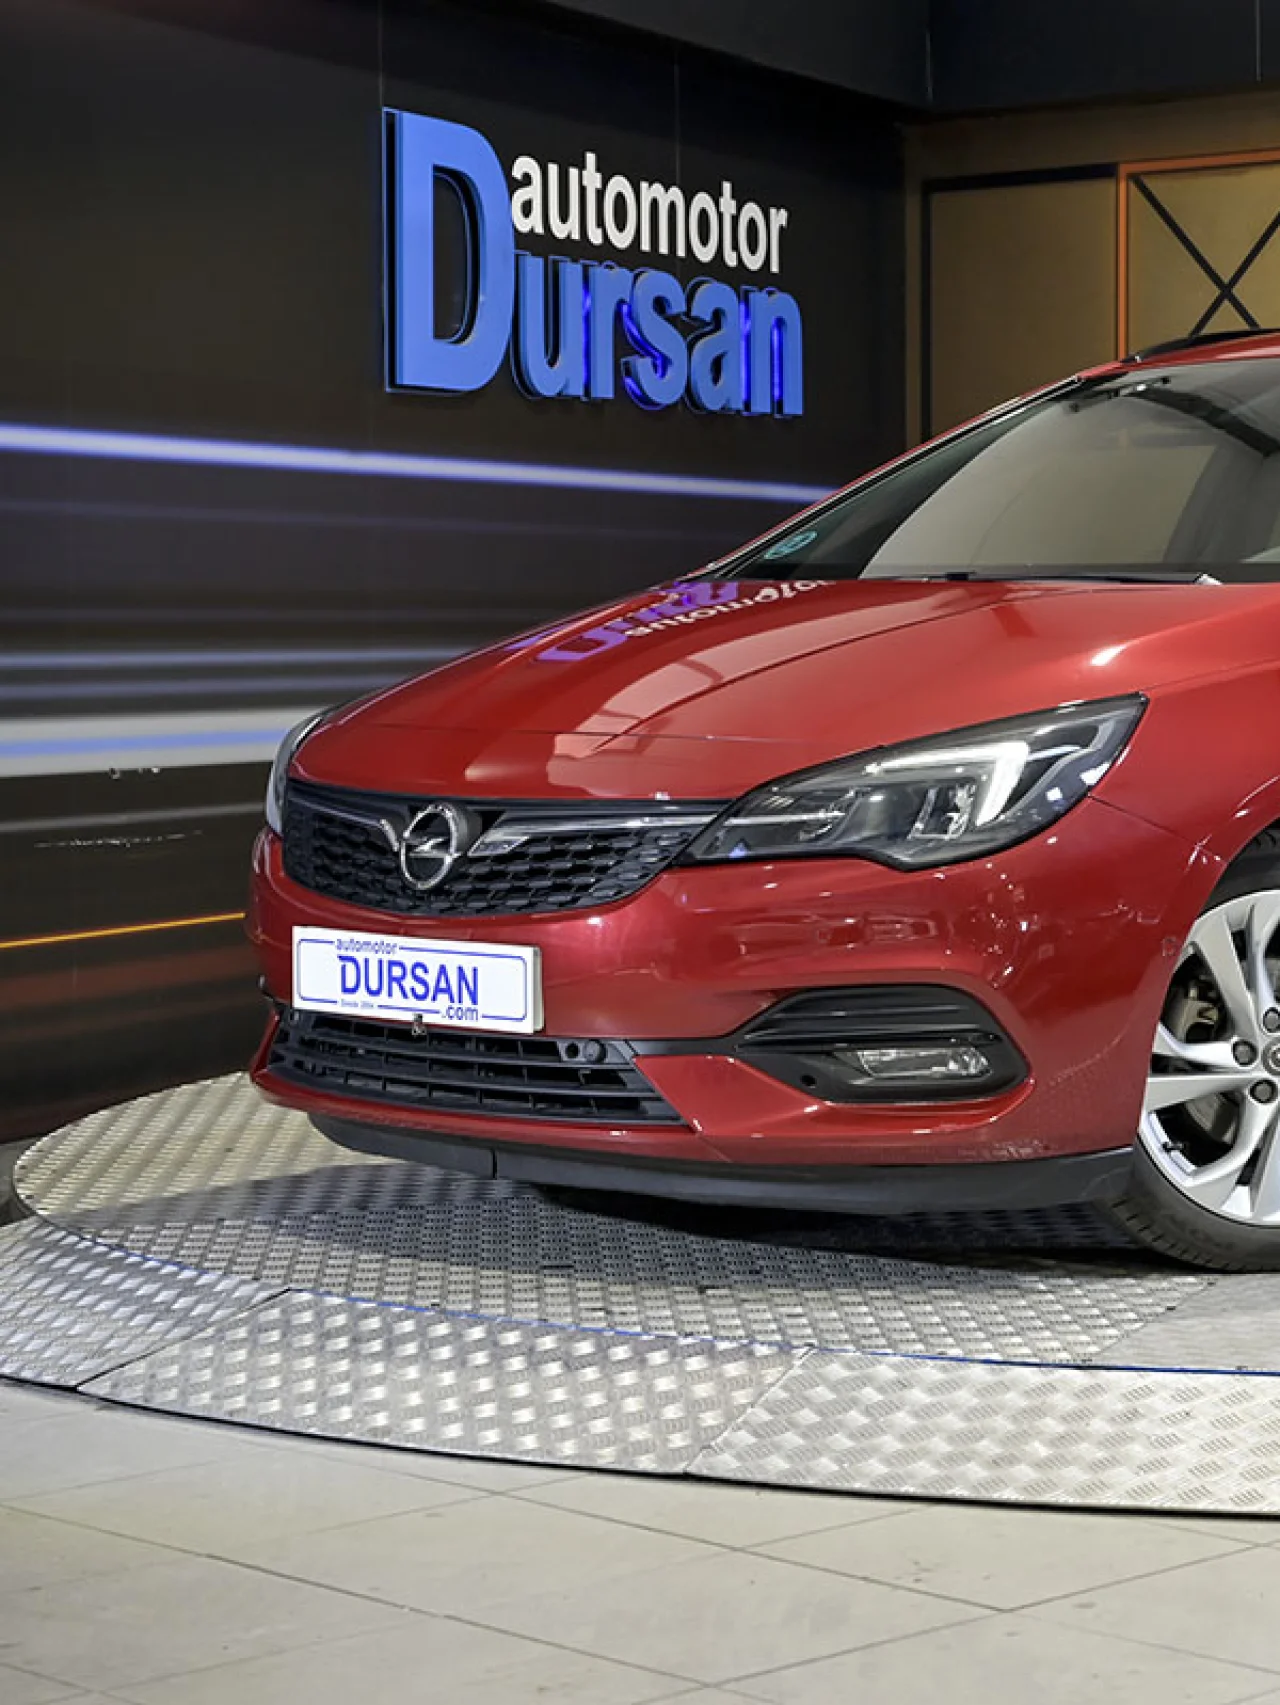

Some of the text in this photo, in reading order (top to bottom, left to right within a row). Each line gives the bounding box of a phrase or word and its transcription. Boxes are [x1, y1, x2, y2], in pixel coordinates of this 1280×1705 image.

[511, 152, 788, 273] automotor
[383, 106, 803, 417] Dursan
[335, 938, 398, 955] automotor
[338, 955, 478, 1005] DURSAN
[441, 1004, 479, 1021] .com
